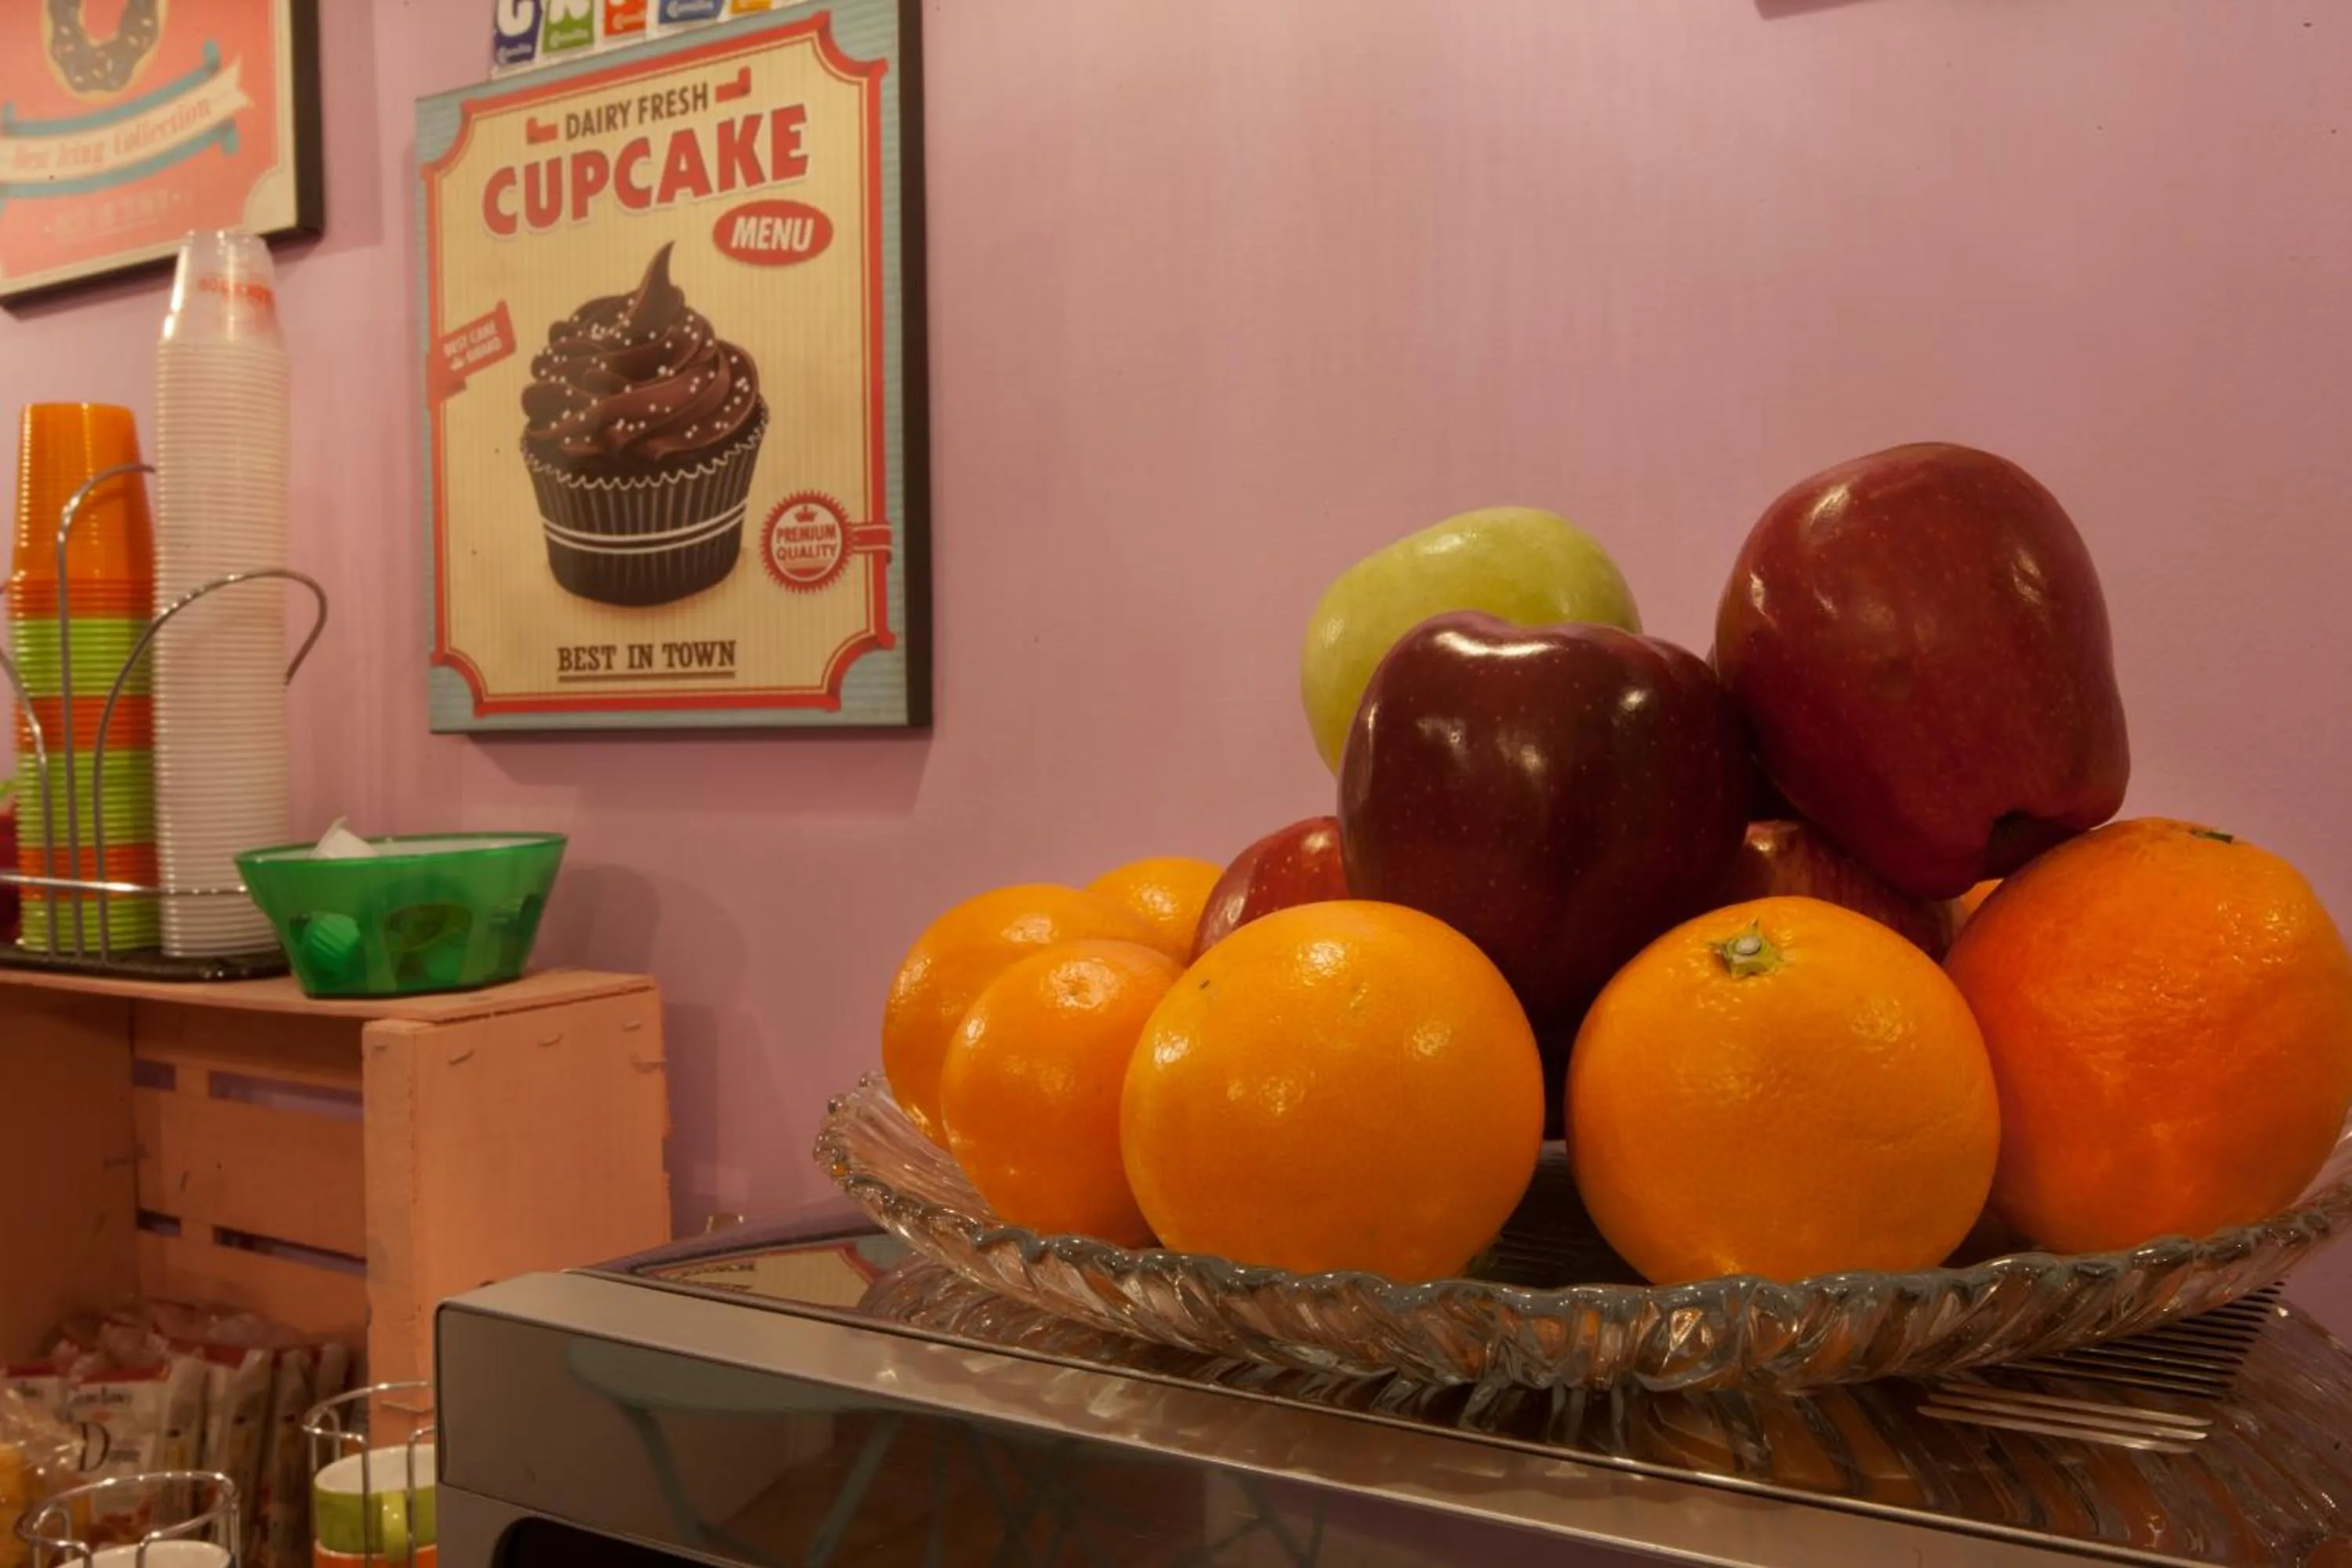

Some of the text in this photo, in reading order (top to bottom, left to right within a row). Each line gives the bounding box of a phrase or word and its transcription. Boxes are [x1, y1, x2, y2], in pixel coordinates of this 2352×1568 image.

[565, 82, 708, 141] DAIRY FRESH
[483, 104, 808, 235] CUPCAKE
[731, 216, 814, 252] MENU
[776, 523, 837, 544] PREMIUM
[776, 544, 837, 561] QUALITY
[557, 640, 736, 672] BEST IN TOWN
